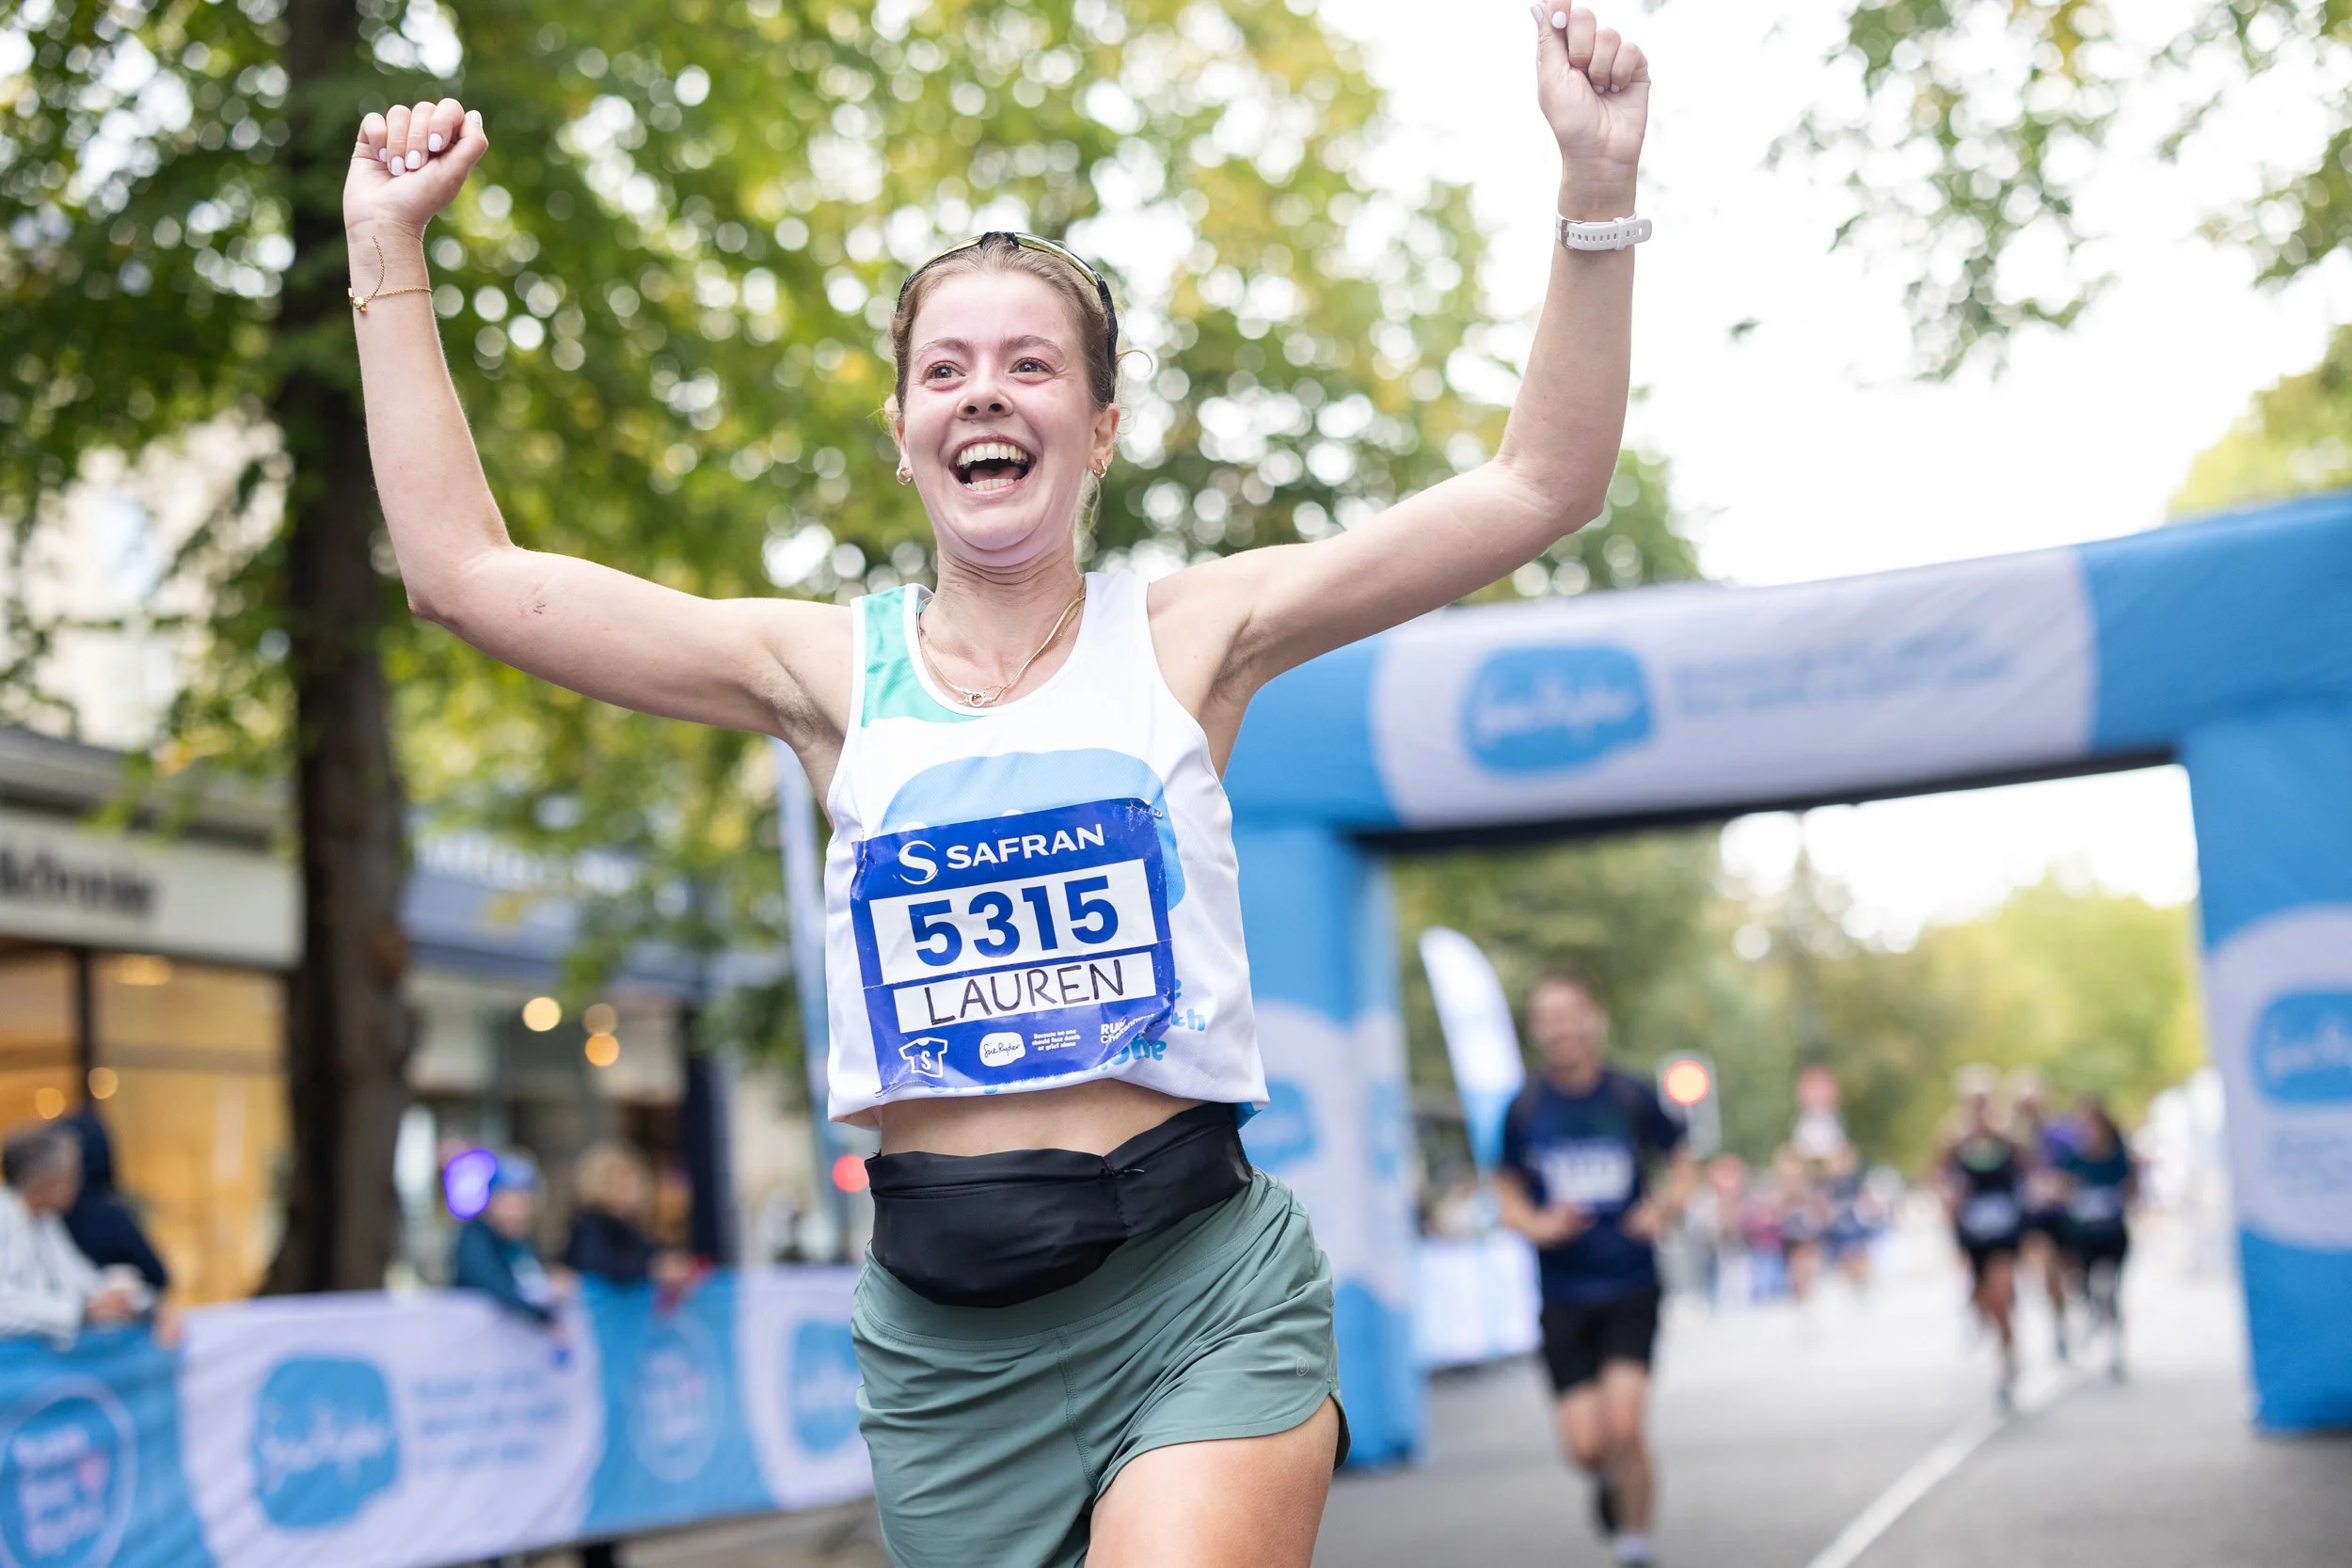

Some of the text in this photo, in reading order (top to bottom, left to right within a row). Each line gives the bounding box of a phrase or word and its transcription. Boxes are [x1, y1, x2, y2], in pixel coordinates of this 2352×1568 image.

[946, 824, 1104, 869] SAFRAN
[908, 875, 1119, 966] 5315
[924, 959, 1123, 1025] LAUREN
[983, 1042, 1020, 1058] Sue Ryder
[1034, 1031, 1057, 1039] Because
[921, 1051, 930, 1070] S
